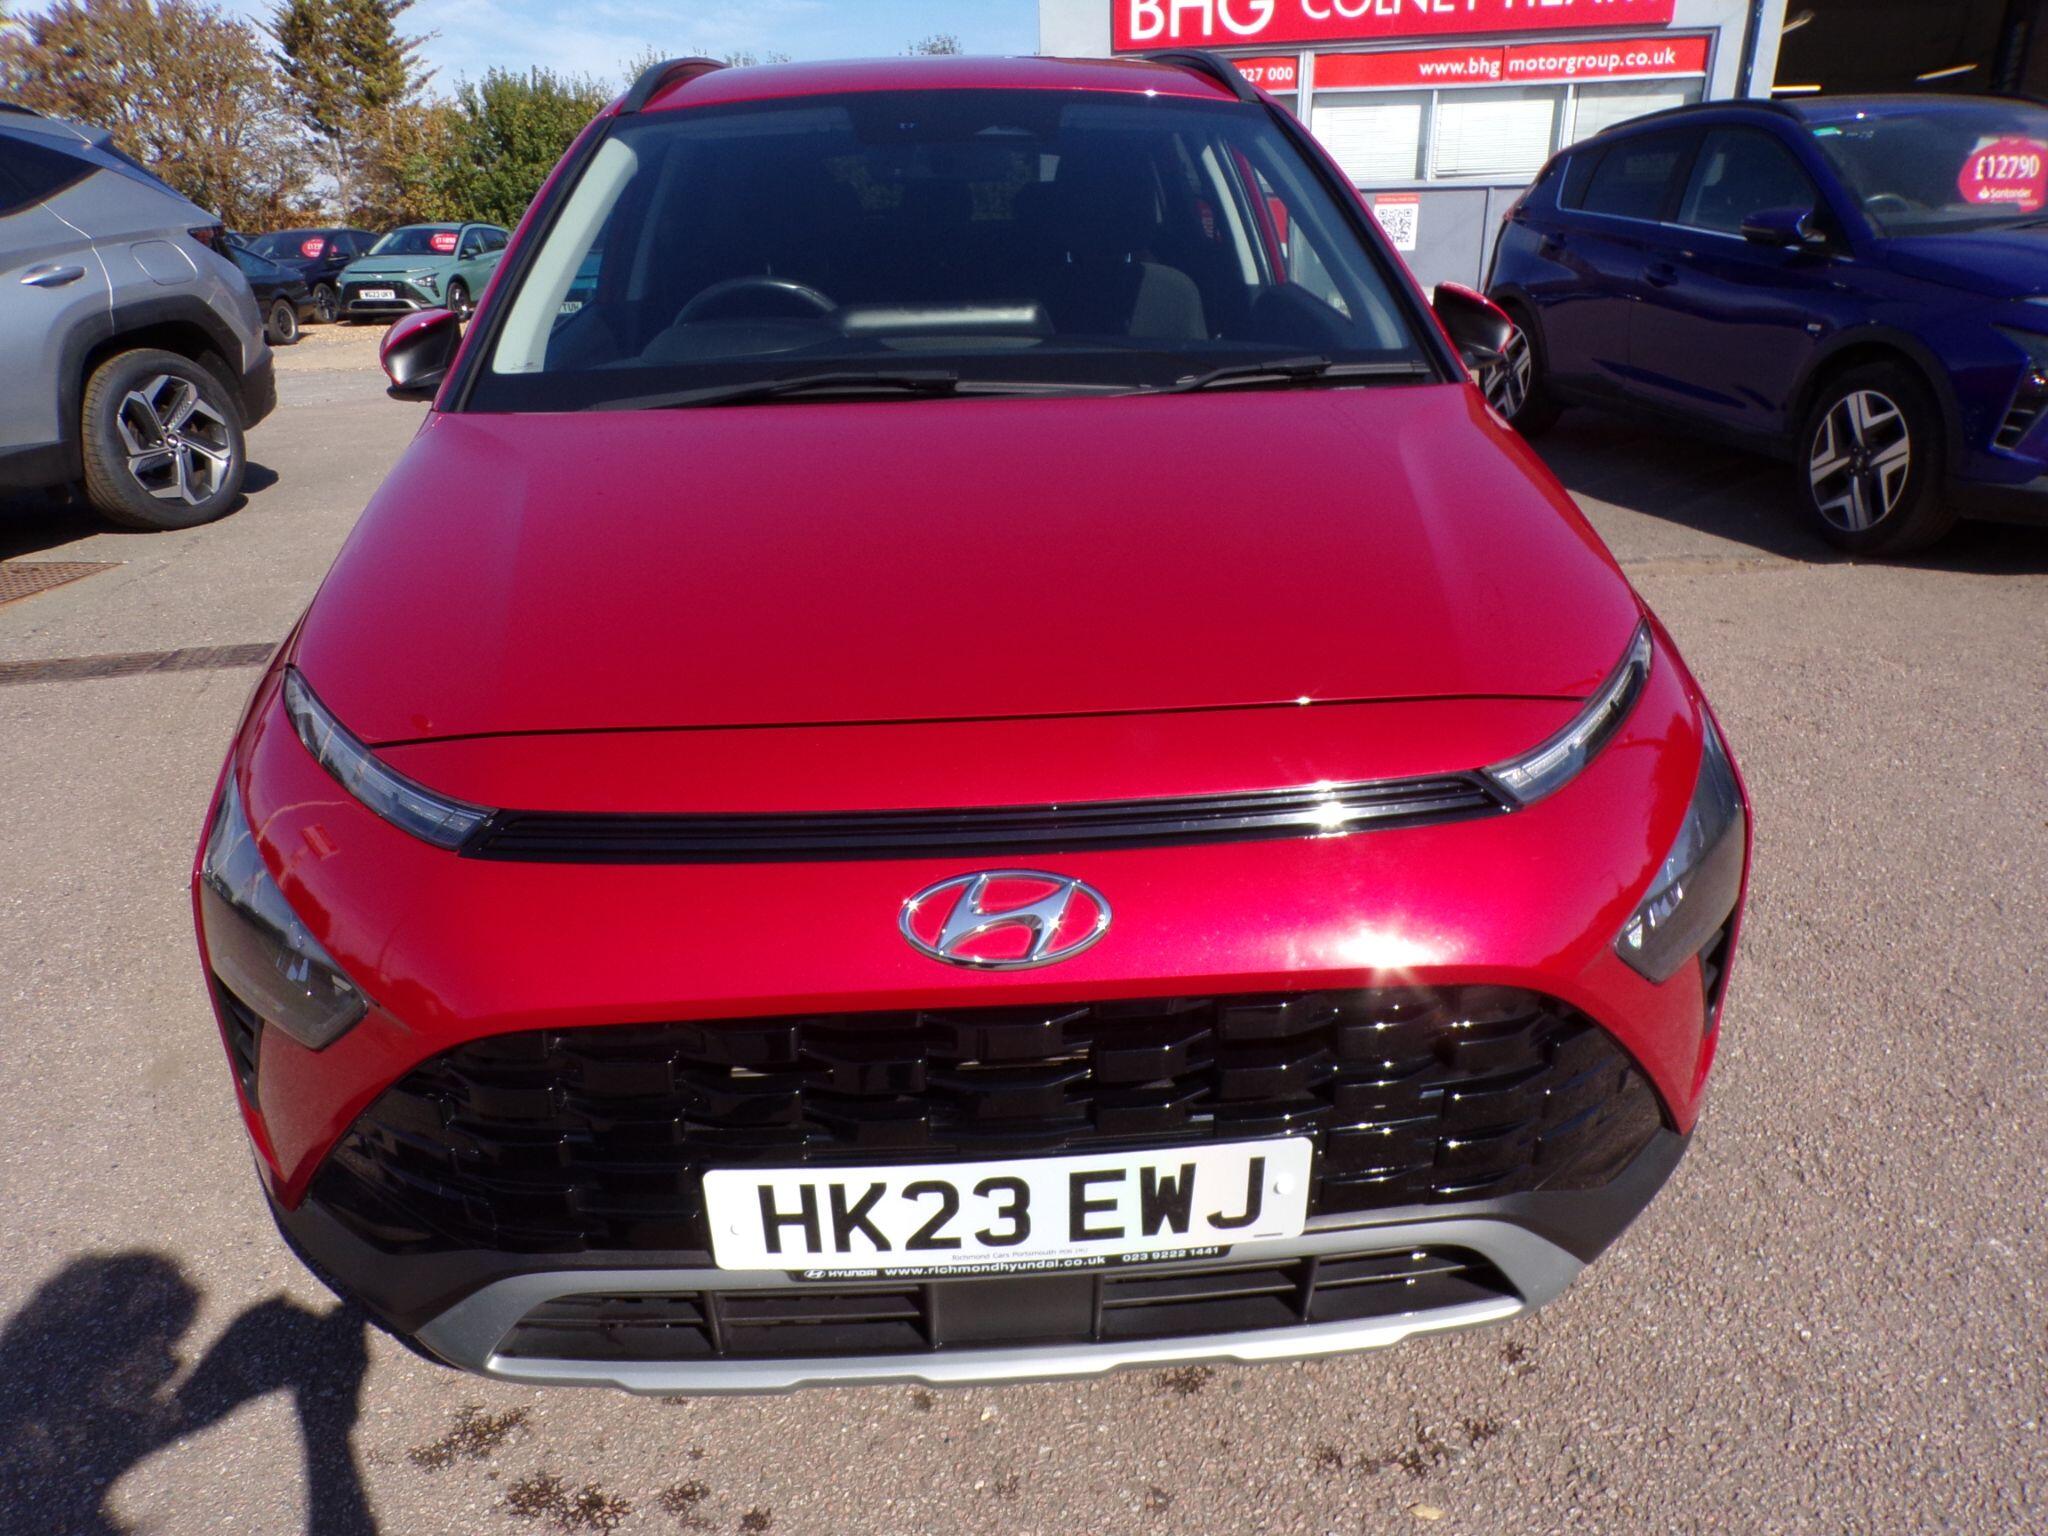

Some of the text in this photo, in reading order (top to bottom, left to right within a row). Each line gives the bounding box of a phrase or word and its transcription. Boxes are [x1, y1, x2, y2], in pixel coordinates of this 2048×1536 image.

[1129, 0, 1275, 40] BHG
[1268, 66, 1294, 81] 000
[1975, 154, 2041, 181] £12790
[756, 1156, 1265, 1255] HK23 EWJ
[828, 1246, 1219, 1277] HYUNDAI www.richmondhyundai.co.uk 023 9222 1441
[952, 1252, 990, 1261] Richmond
[993, 1251, 1010, 1259] Cars
